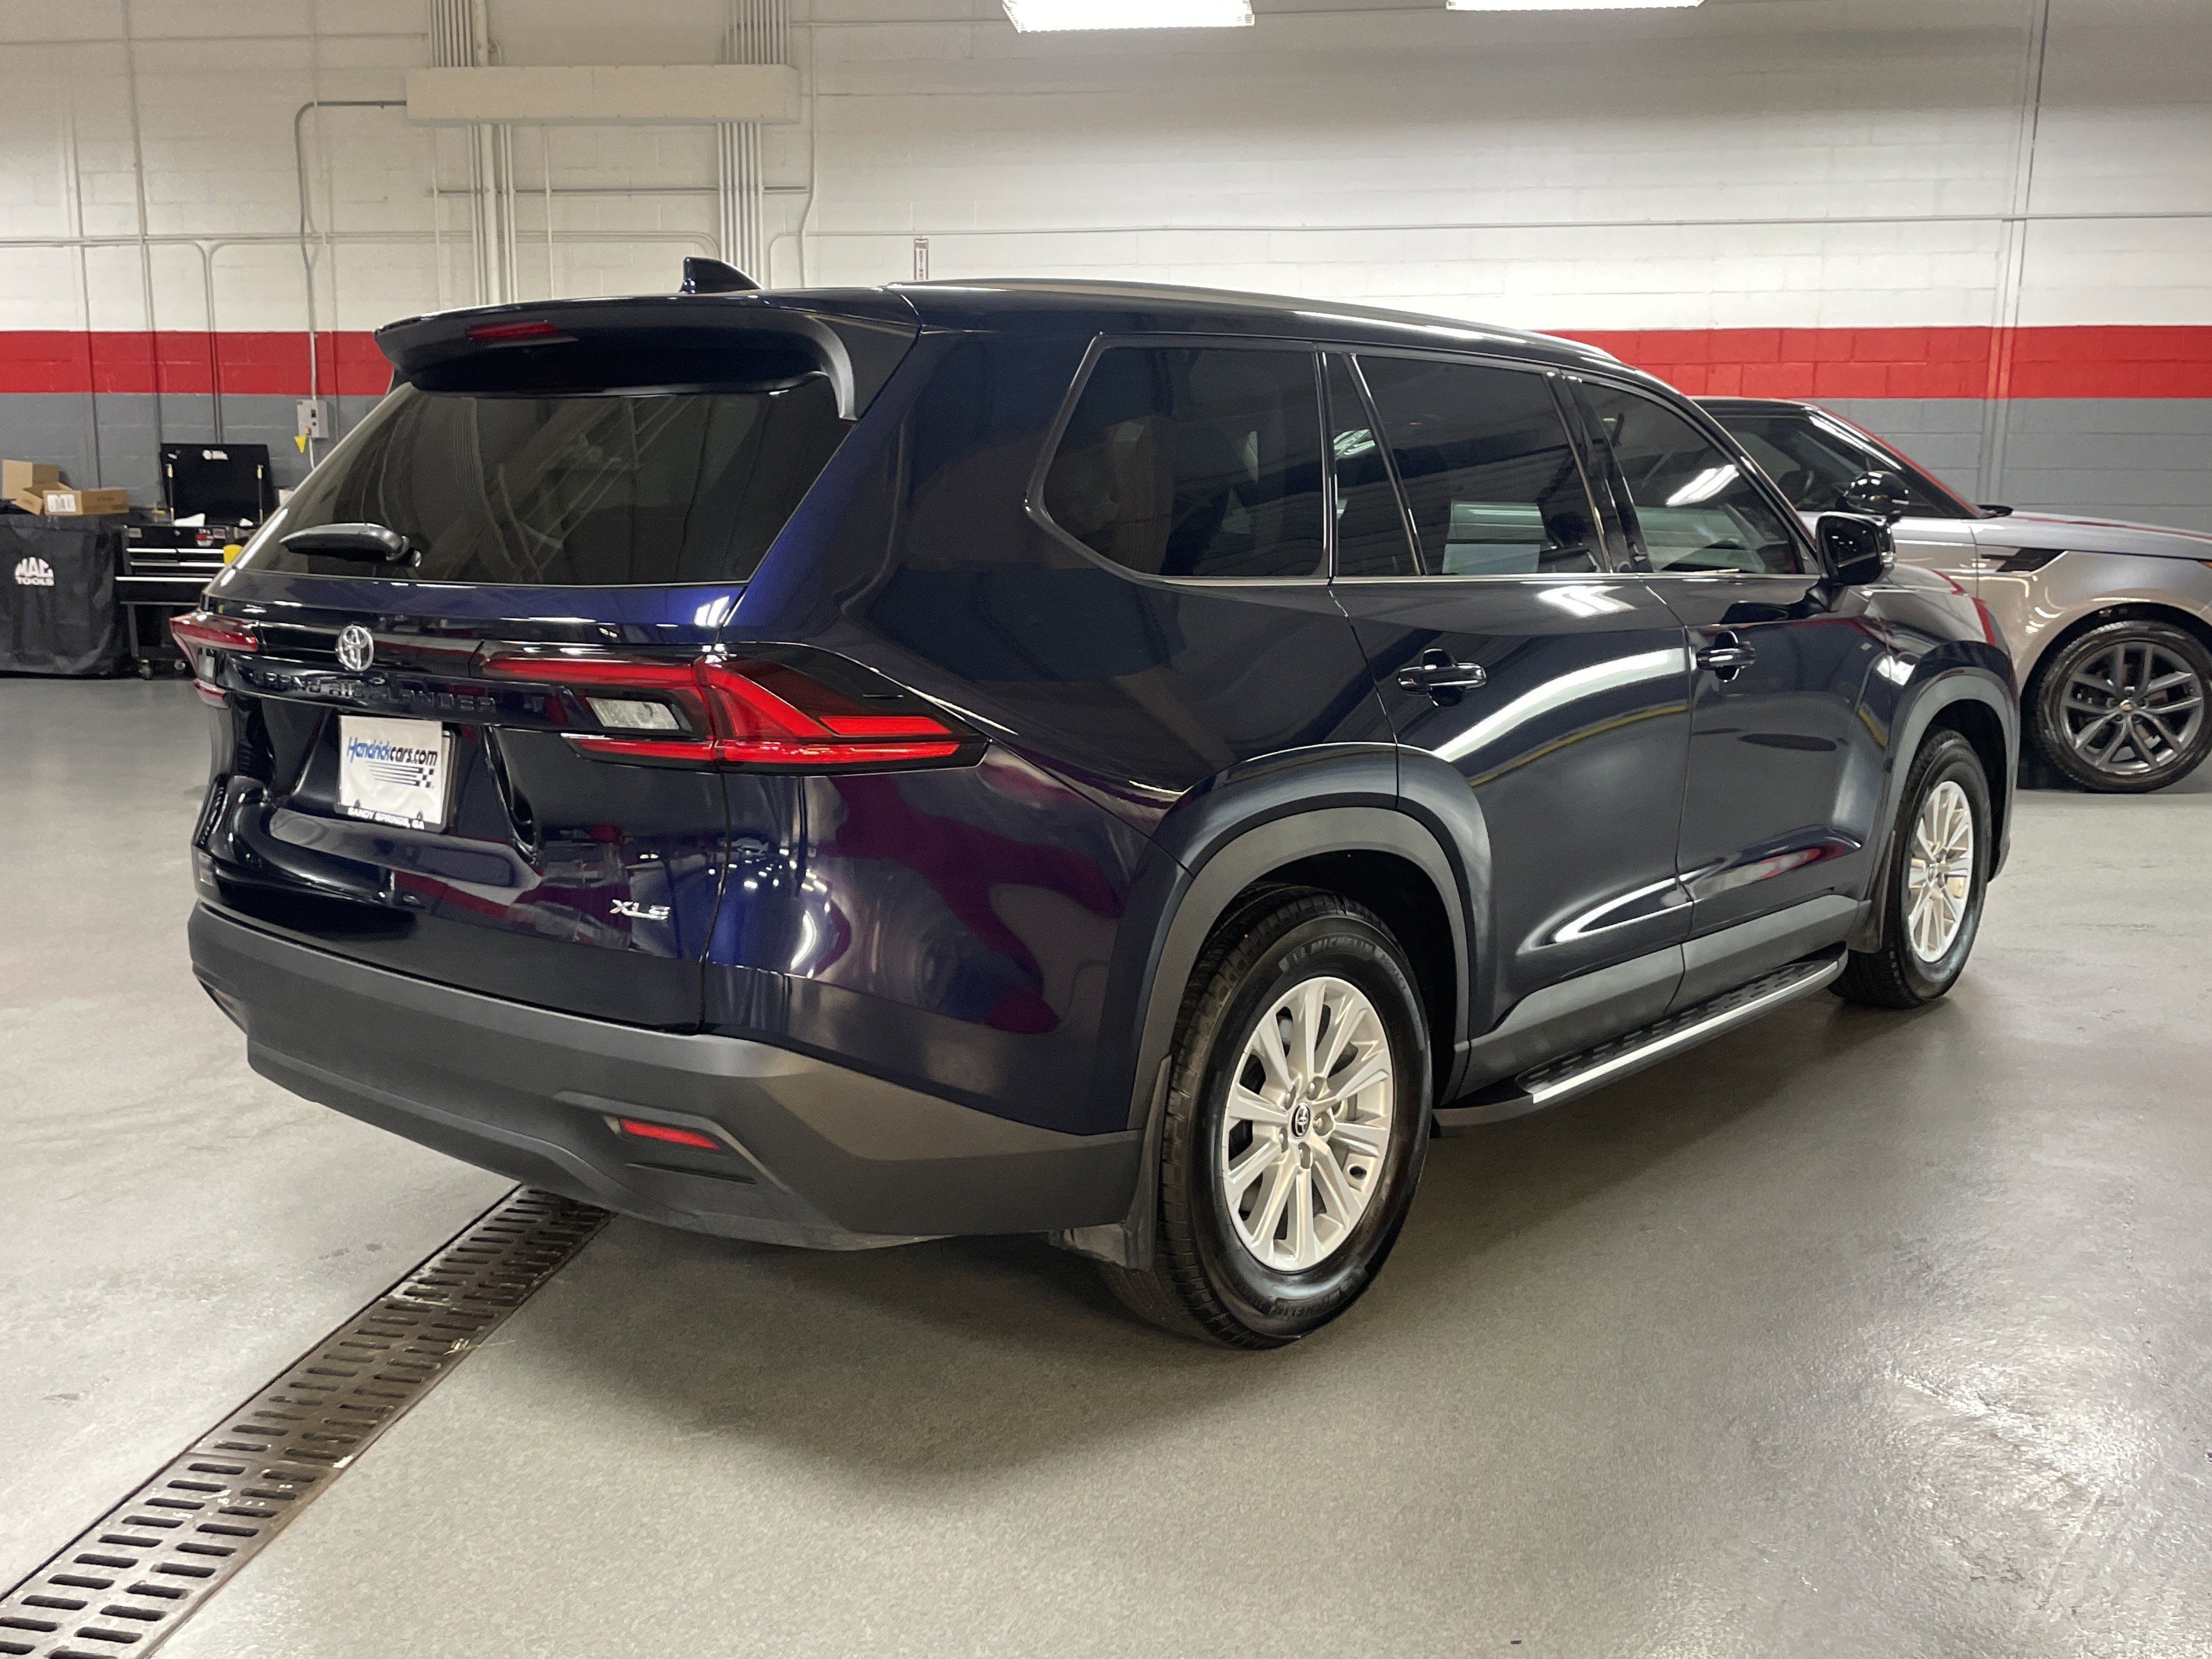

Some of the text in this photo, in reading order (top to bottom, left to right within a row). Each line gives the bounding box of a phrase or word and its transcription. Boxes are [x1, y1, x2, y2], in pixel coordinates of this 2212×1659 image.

[15, 556, 54, 577] MAC
[15, 577, 55, 586] TOOLS
[610, 900, 670, 920] XLE
